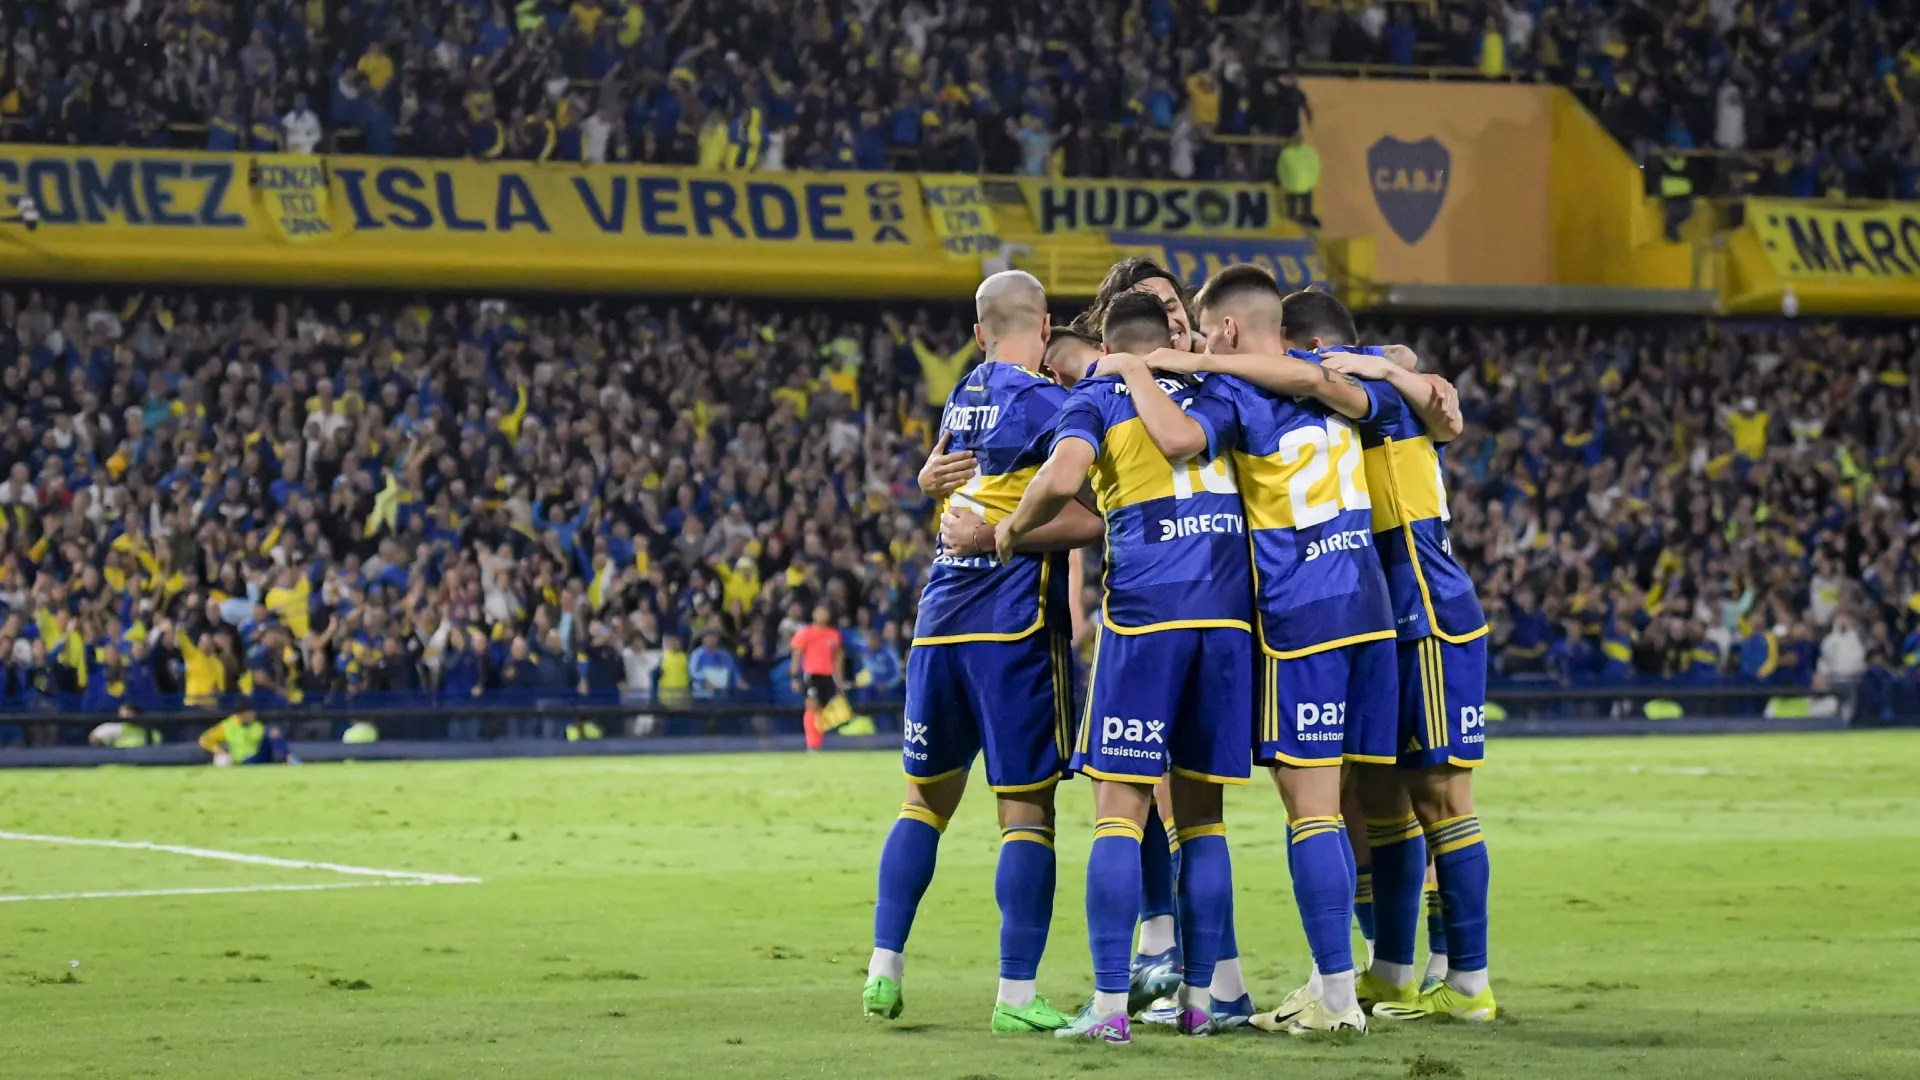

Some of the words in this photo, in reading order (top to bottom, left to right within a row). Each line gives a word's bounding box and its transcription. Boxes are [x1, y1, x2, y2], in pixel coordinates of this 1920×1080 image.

[334, 167, 552, 233] ISLA
[570, 175, 855, 242] VERDE
[1041, 186, 1269, 232] HUDSON
[1159, 513, 1243, 542] DIRECTV
[1304, 528, 1371, 562] DIRECT
[1102, 716, 1165, 745] pax
[1101, 745, 1162, 760] assistance
